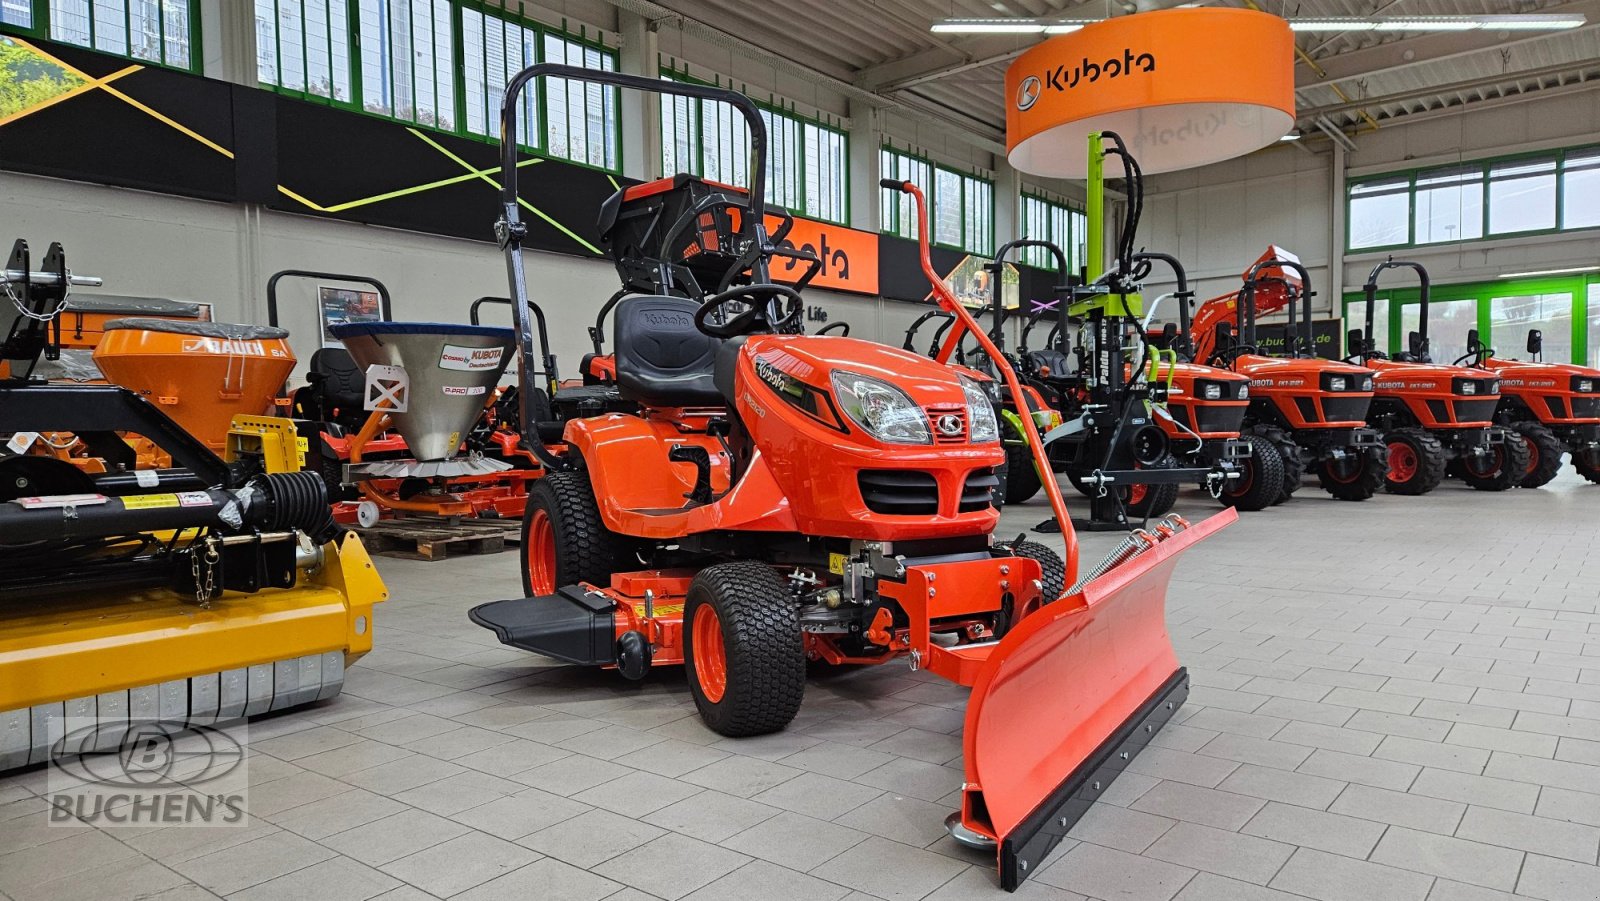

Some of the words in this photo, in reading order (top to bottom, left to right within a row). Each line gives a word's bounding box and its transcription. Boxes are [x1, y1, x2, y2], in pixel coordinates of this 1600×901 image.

[1046, 48, 1155, 92] Kubota
[807, 305, 827, 322] Life
[471, 349, 502, 360] KUBOTA
[758, 361, 785, 391] Kubota
[1099, 350, 1109, 385] Paldu
[1377, 381, 1405, 389] KUBOTA
